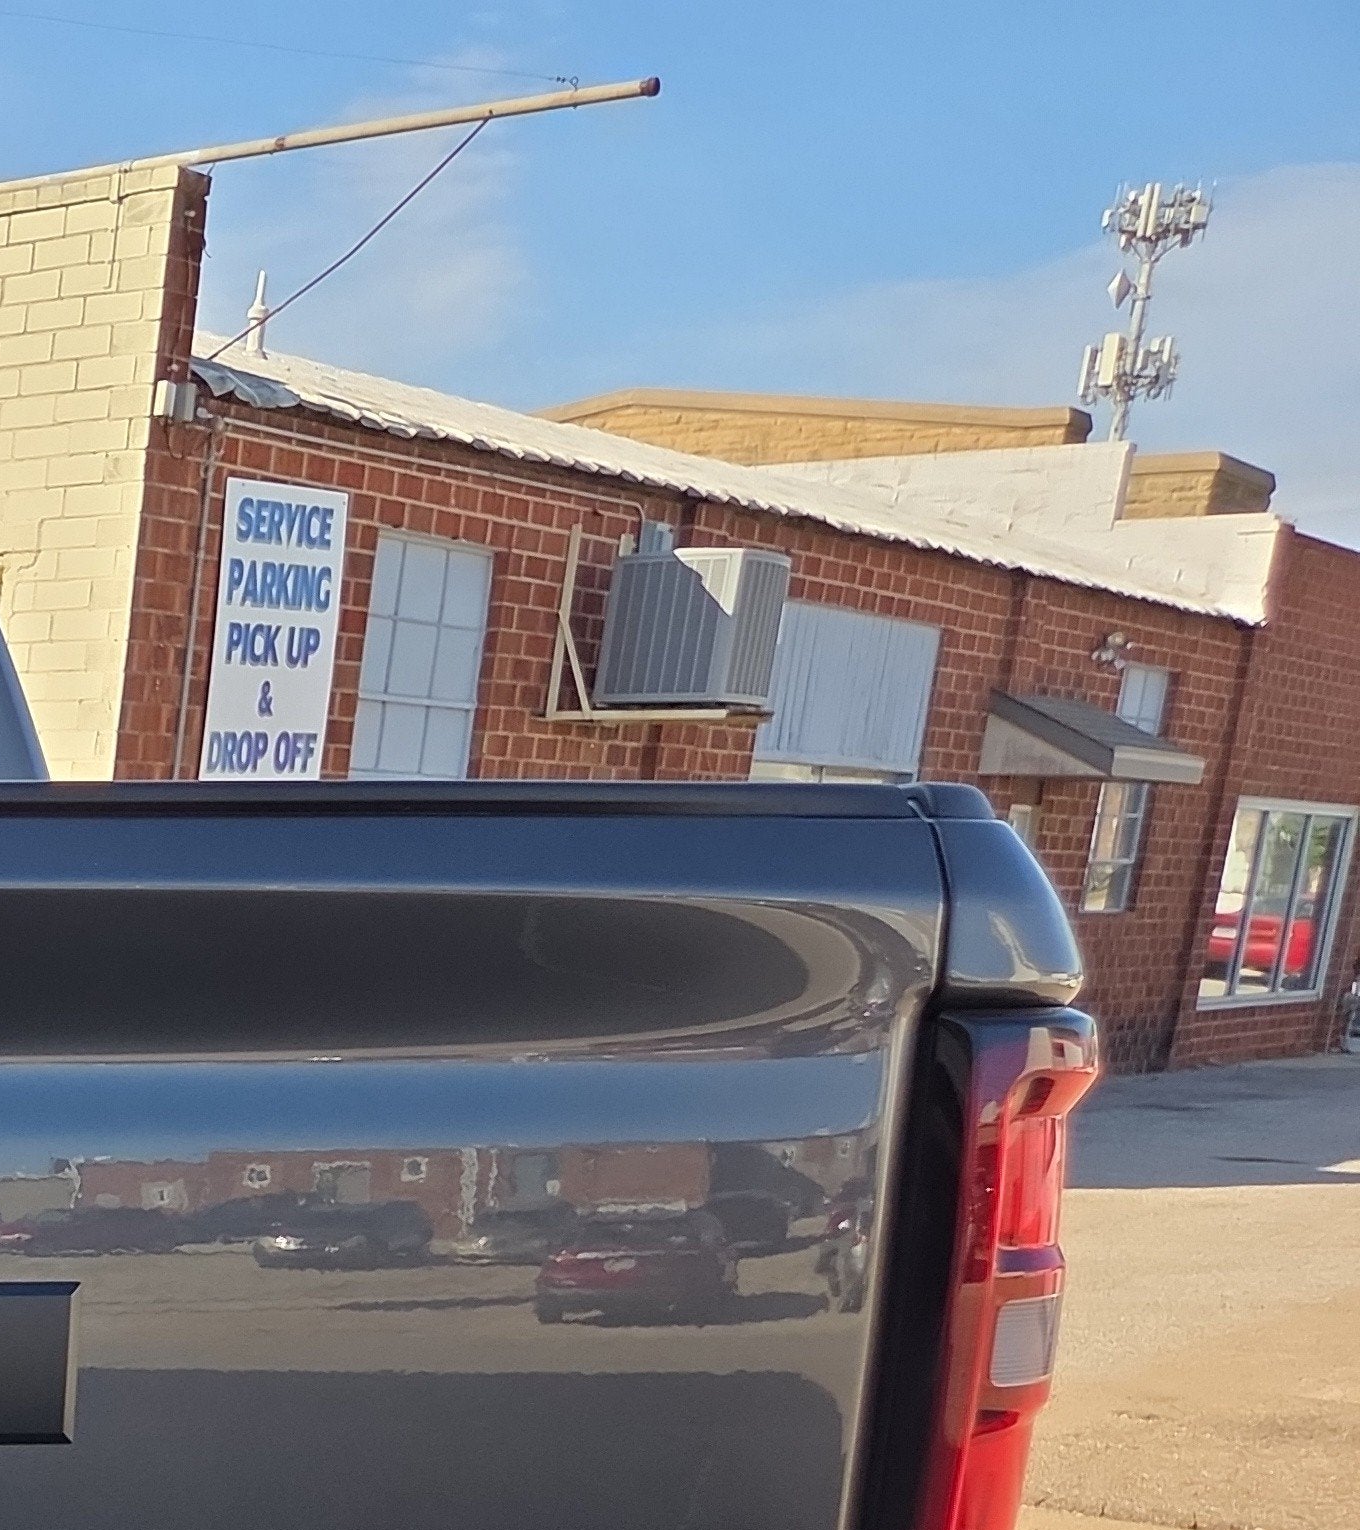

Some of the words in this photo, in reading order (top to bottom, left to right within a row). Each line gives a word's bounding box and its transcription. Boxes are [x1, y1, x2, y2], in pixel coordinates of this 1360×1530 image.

[236, 497, 334, 550] SERVICE
[226, 558, 332, 612] PARKING
[225, 622, 282, 667] PICK
[286, 626, 321, 668] UP
[257, 680, 274, 718] &
[205, 730, 269, 774] DROP
[273, 731, 318, 774] OFF
